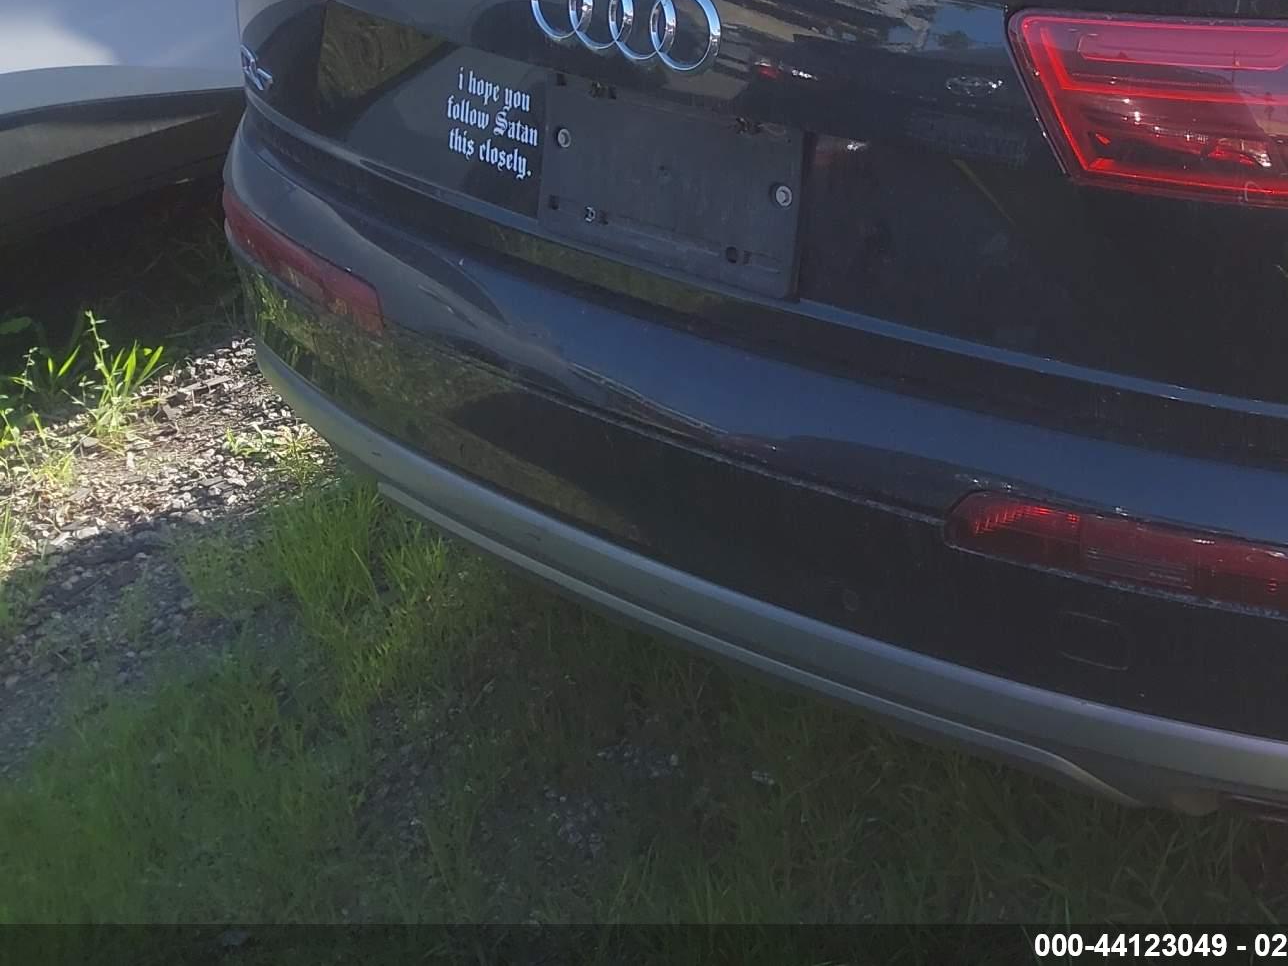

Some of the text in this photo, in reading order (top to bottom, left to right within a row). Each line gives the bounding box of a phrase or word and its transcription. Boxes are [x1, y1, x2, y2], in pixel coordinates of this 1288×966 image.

[458, 66, 530, 112] i hope you
[447, 95, 538, 147] follow Satan
[449, 127, 532, 179] this closely.
